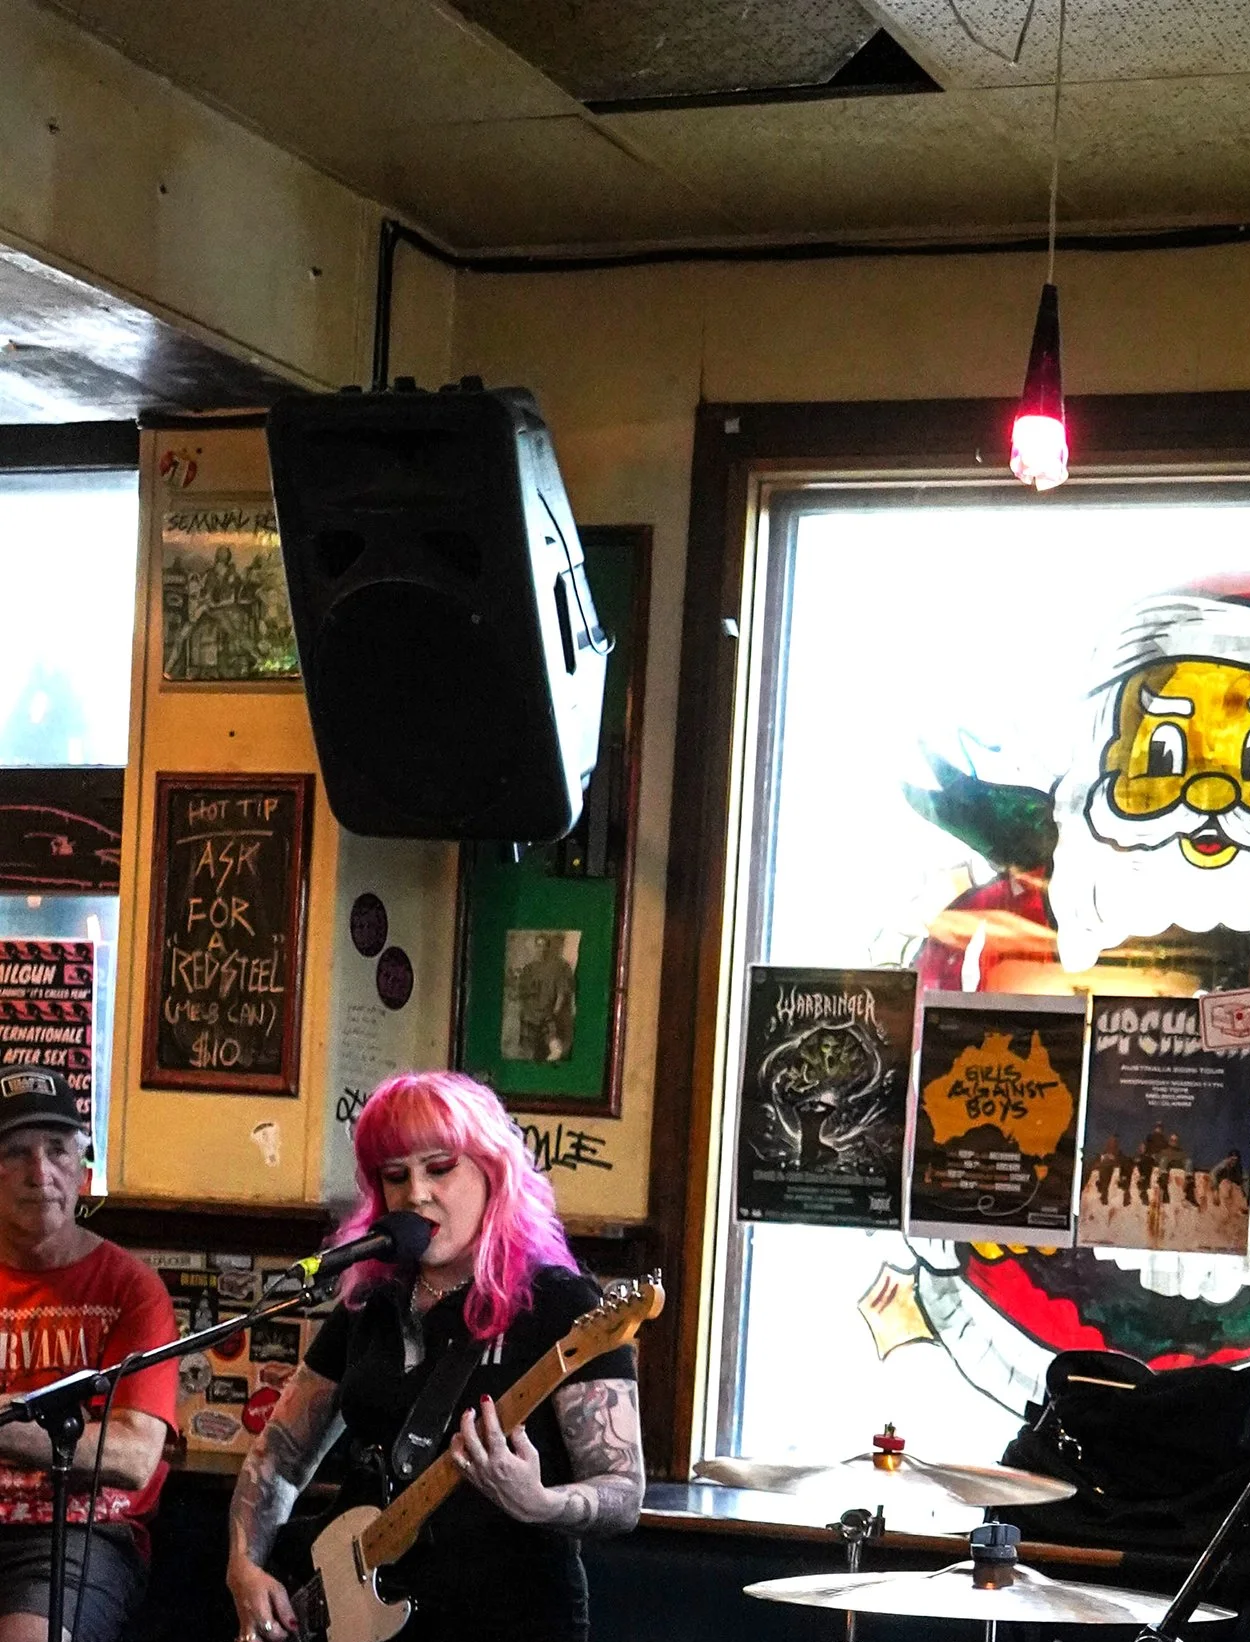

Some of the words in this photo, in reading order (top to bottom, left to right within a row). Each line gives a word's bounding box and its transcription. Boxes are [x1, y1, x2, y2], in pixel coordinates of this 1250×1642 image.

[188, 800, 231, 826] HOT
[236, 799, 279, 821] TIP
[195, 839, 261, 891] ASK
[187, 897, 255, 936] FOR
[207, 931, 226, 951] A
[3, 1047, 41, 1065] AFTER
[43, 1049, 68, 1067] SEX
[189, 1031, 240, 1068] $10
[67, 1072, 92, 1092] DEC
[965, 1064, 1022, 1083] GIRLS
[948, 1080, 1059, 1099] AGAINST
[966, 1097, 1029, 1122] BOYS
